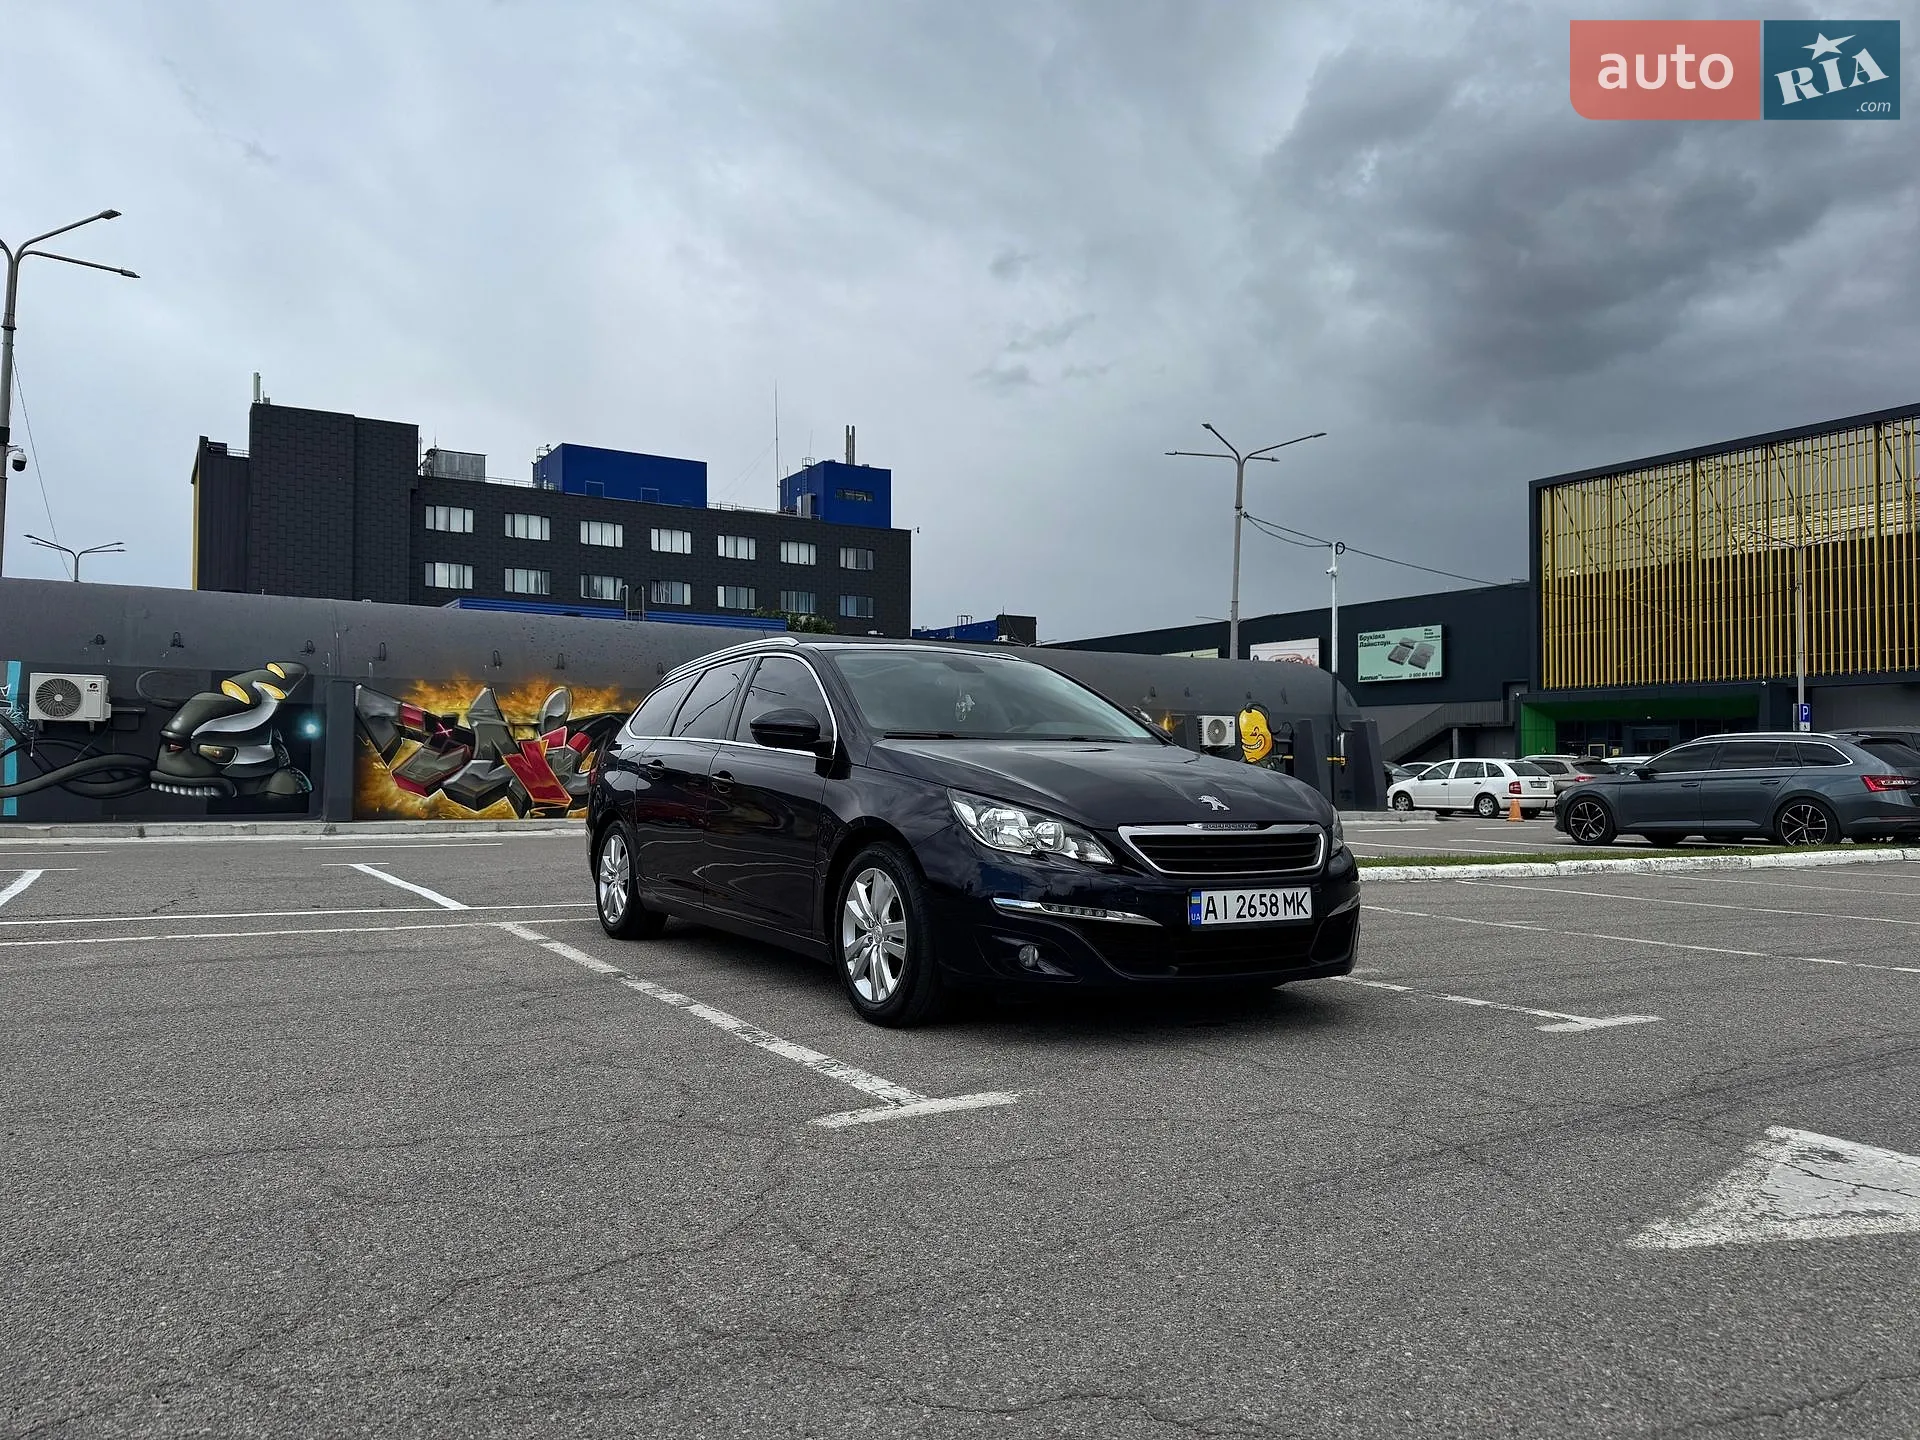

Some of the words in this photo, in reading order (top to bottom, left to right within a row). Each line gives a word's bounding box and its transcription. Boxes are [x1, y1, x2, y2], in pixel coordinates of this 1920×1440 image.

[1802, 706, 1809, 720] P
[1204, 895, 1228, 920] AI
[1236, 893, 1279, 919] 2658
[1282, 891, 1309, 916] MK
